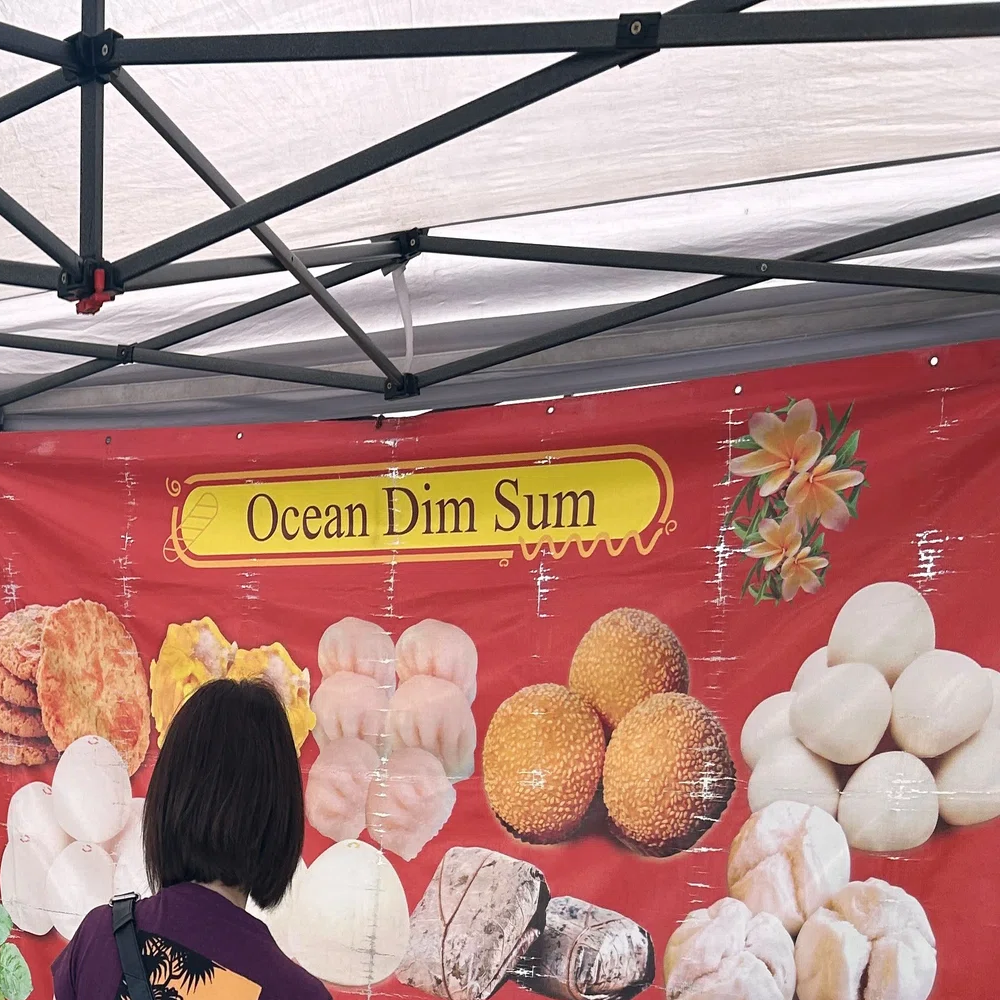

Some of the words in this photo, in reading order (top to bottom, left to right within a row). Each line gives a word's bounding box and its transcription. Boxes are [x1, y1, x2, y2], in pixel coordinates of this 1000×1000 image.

[246, 492, 369, 542] Ocean
[382, 482, 478, 537] Dim
[493, 478, 597, 533] Sum
